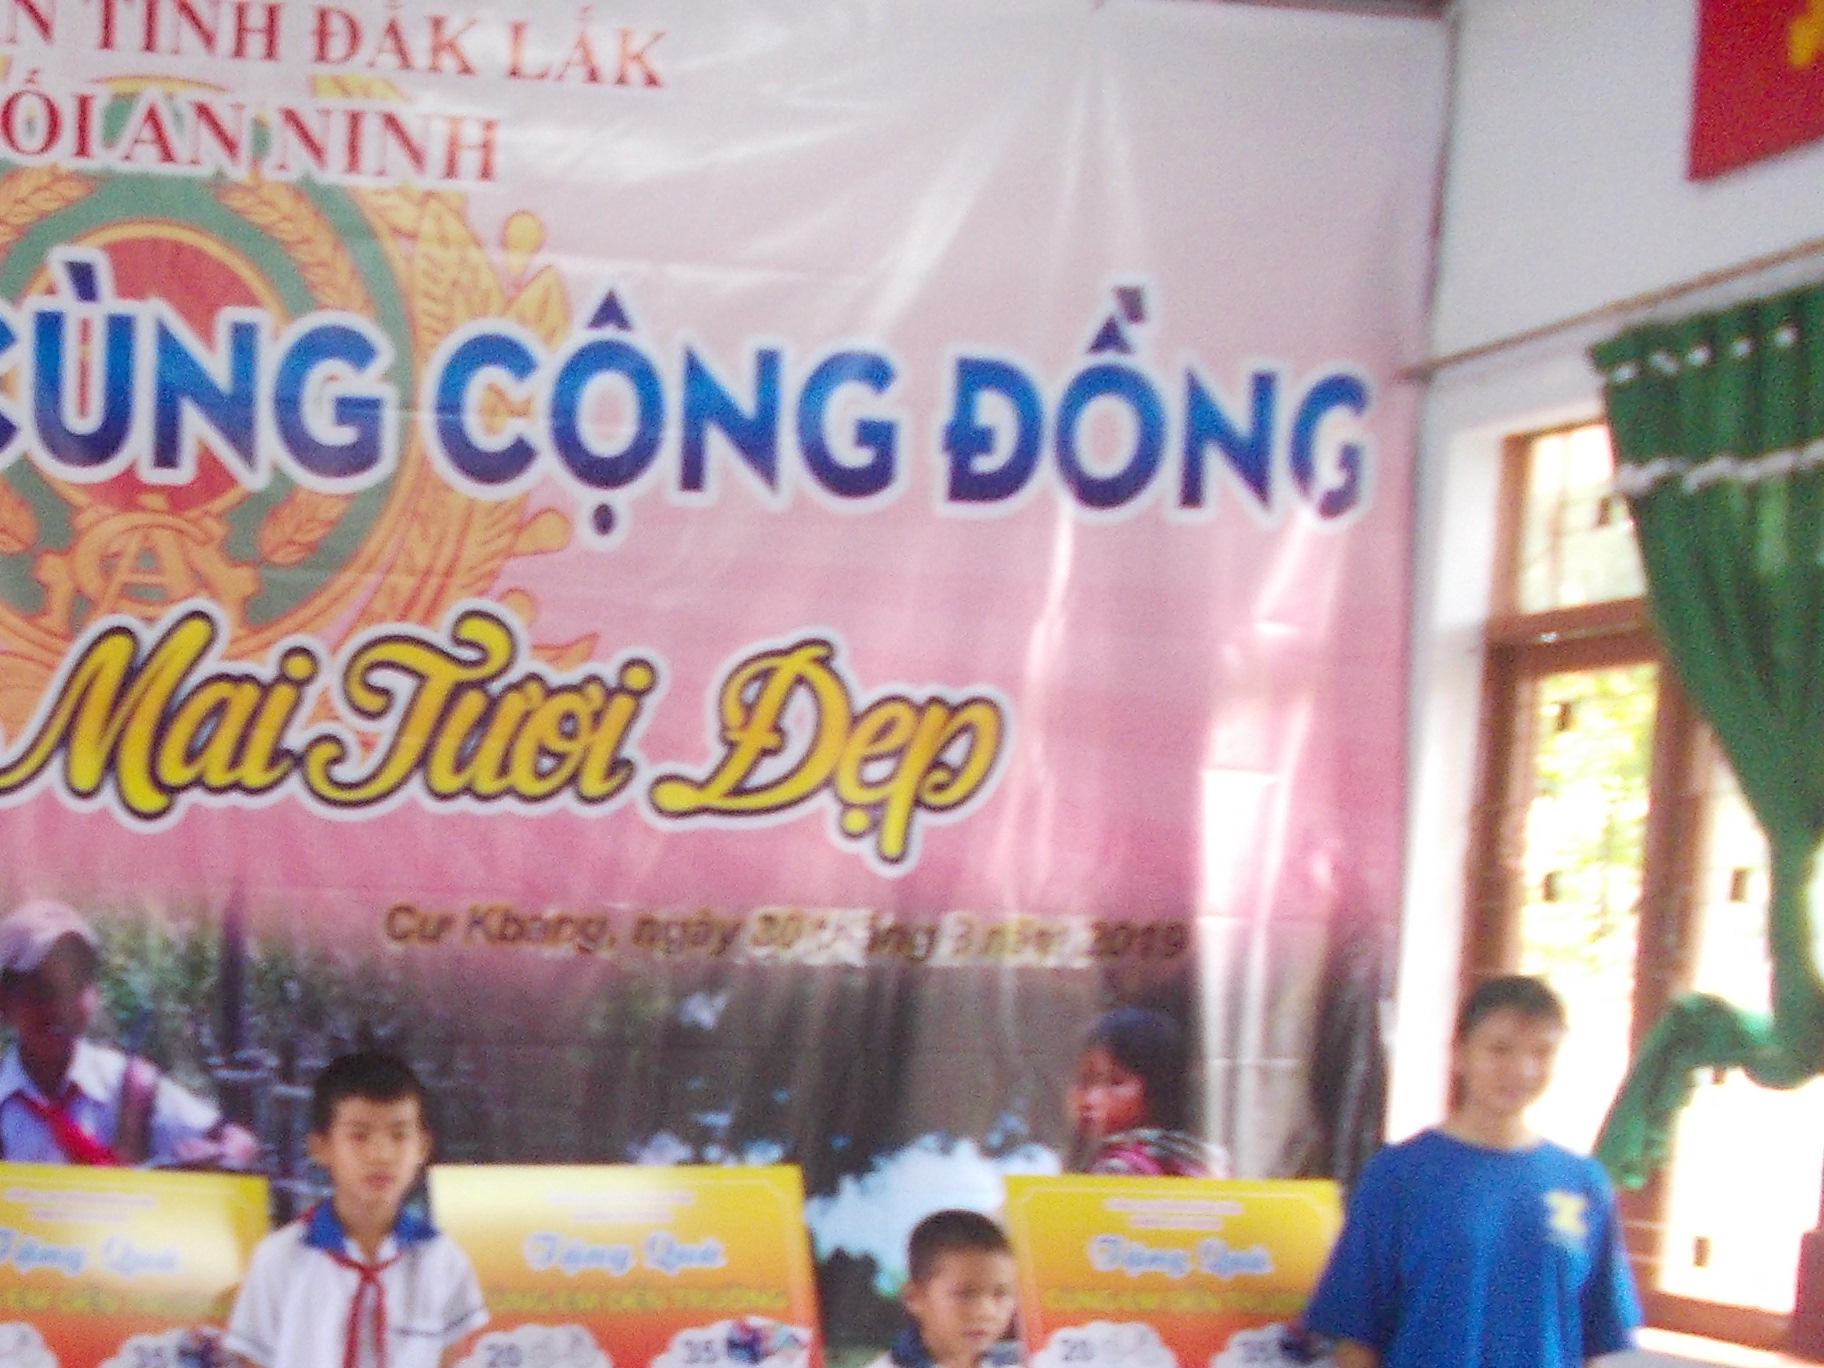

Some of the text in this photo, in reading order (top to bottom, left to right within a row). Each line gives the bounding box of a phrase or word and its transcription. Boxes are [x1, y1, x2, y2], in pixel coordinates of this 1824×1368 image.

[119, 98, 245, 168] AN
[271, 107, 502, 181] NINH
[436, 288, 899, 536] CỘNG
[943, 286, 1369, 520] ĐỒNG
[302, 609, 658, 808] Tươi
[649, 638, 1003, 864] Đẹp
